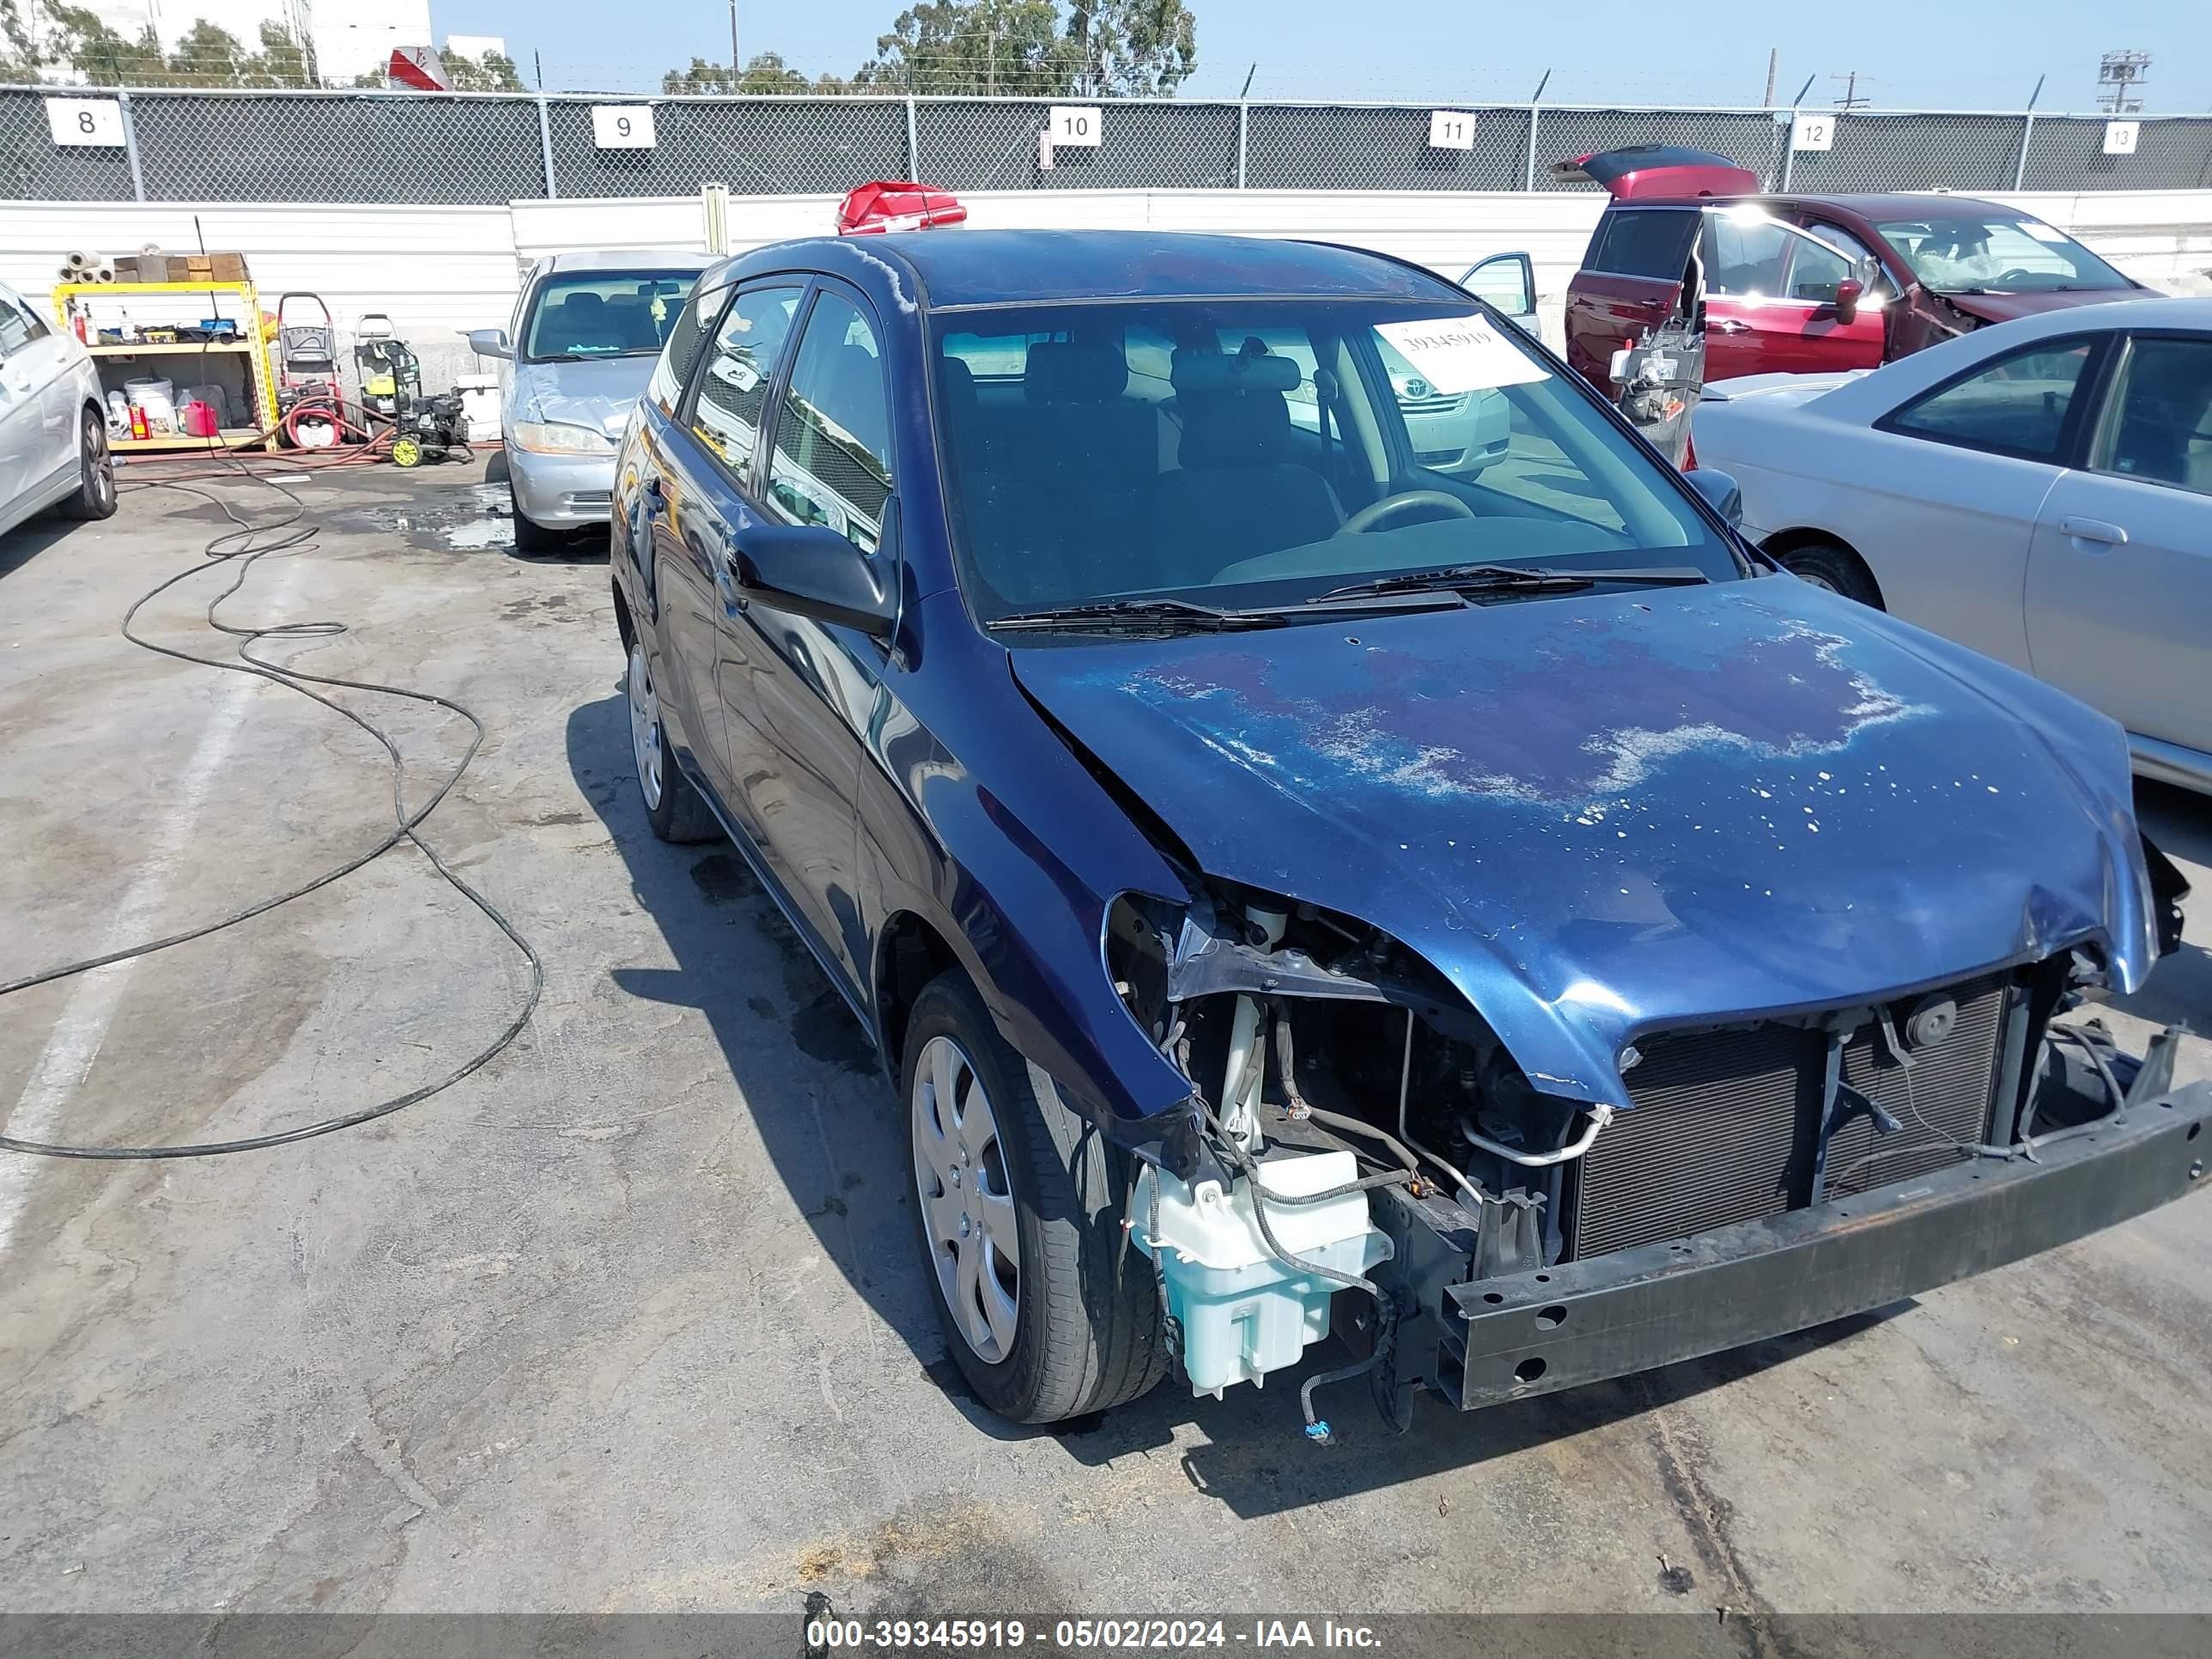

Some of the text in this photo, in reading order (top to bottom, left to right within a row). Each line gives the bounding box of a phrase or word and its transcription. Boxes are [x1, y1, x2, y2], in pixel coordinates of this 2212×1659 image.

[78, 112, 96, 134] 8
[617, 117, 631, 137] 9
[1064, 117, 1088, 136] 10
[1443, 122, 1462, 140] 11
[1805, 125, 1824, 143] 12
[2113, 131, 2130, 146] 13
[1403, 331, 1492, 351] 39345919
